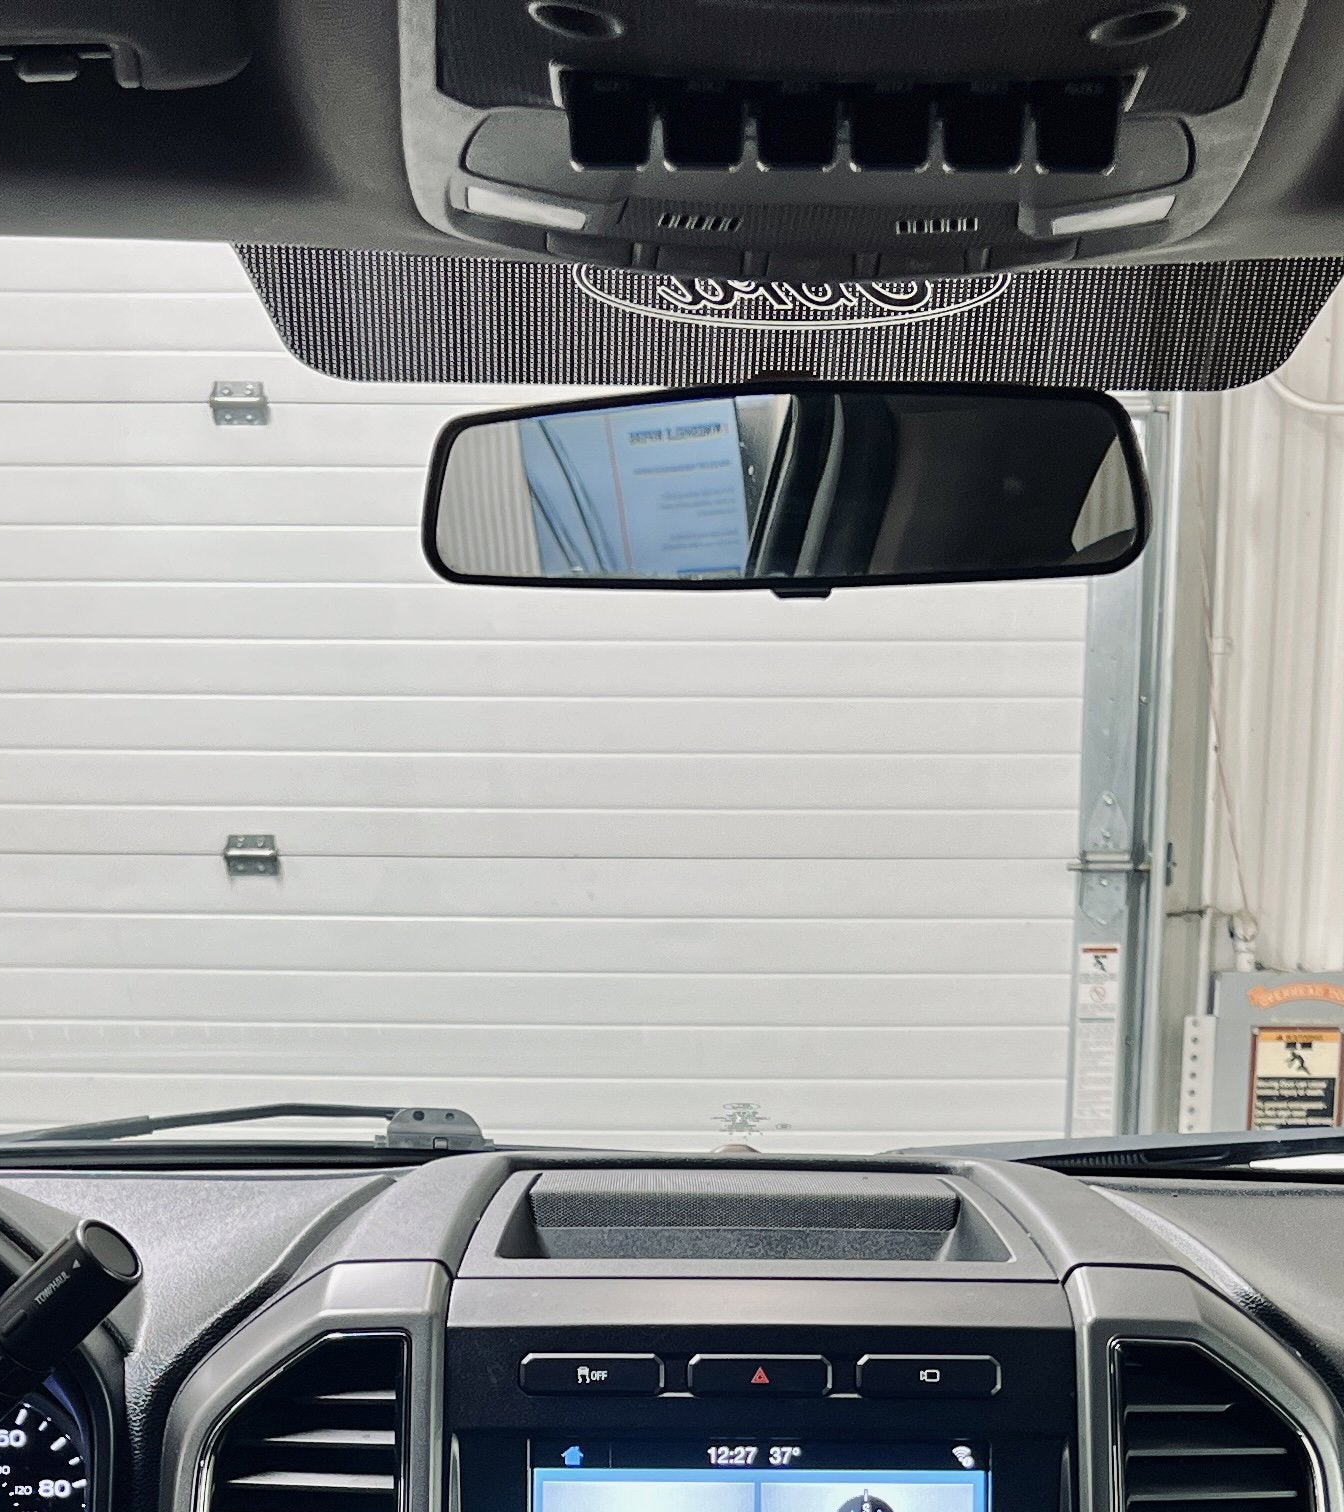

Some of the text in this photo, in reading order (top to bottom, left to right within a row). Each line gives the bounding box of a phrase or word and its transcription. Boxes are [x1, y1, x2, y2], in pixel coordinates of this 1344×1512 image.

[590, 1369, 608, 1381] OFF
[708, 1446, 801, 1464] 12:27 37°
[14, 1485, 32, 1496] 120
[38, 1479, 72, 1498] 80
